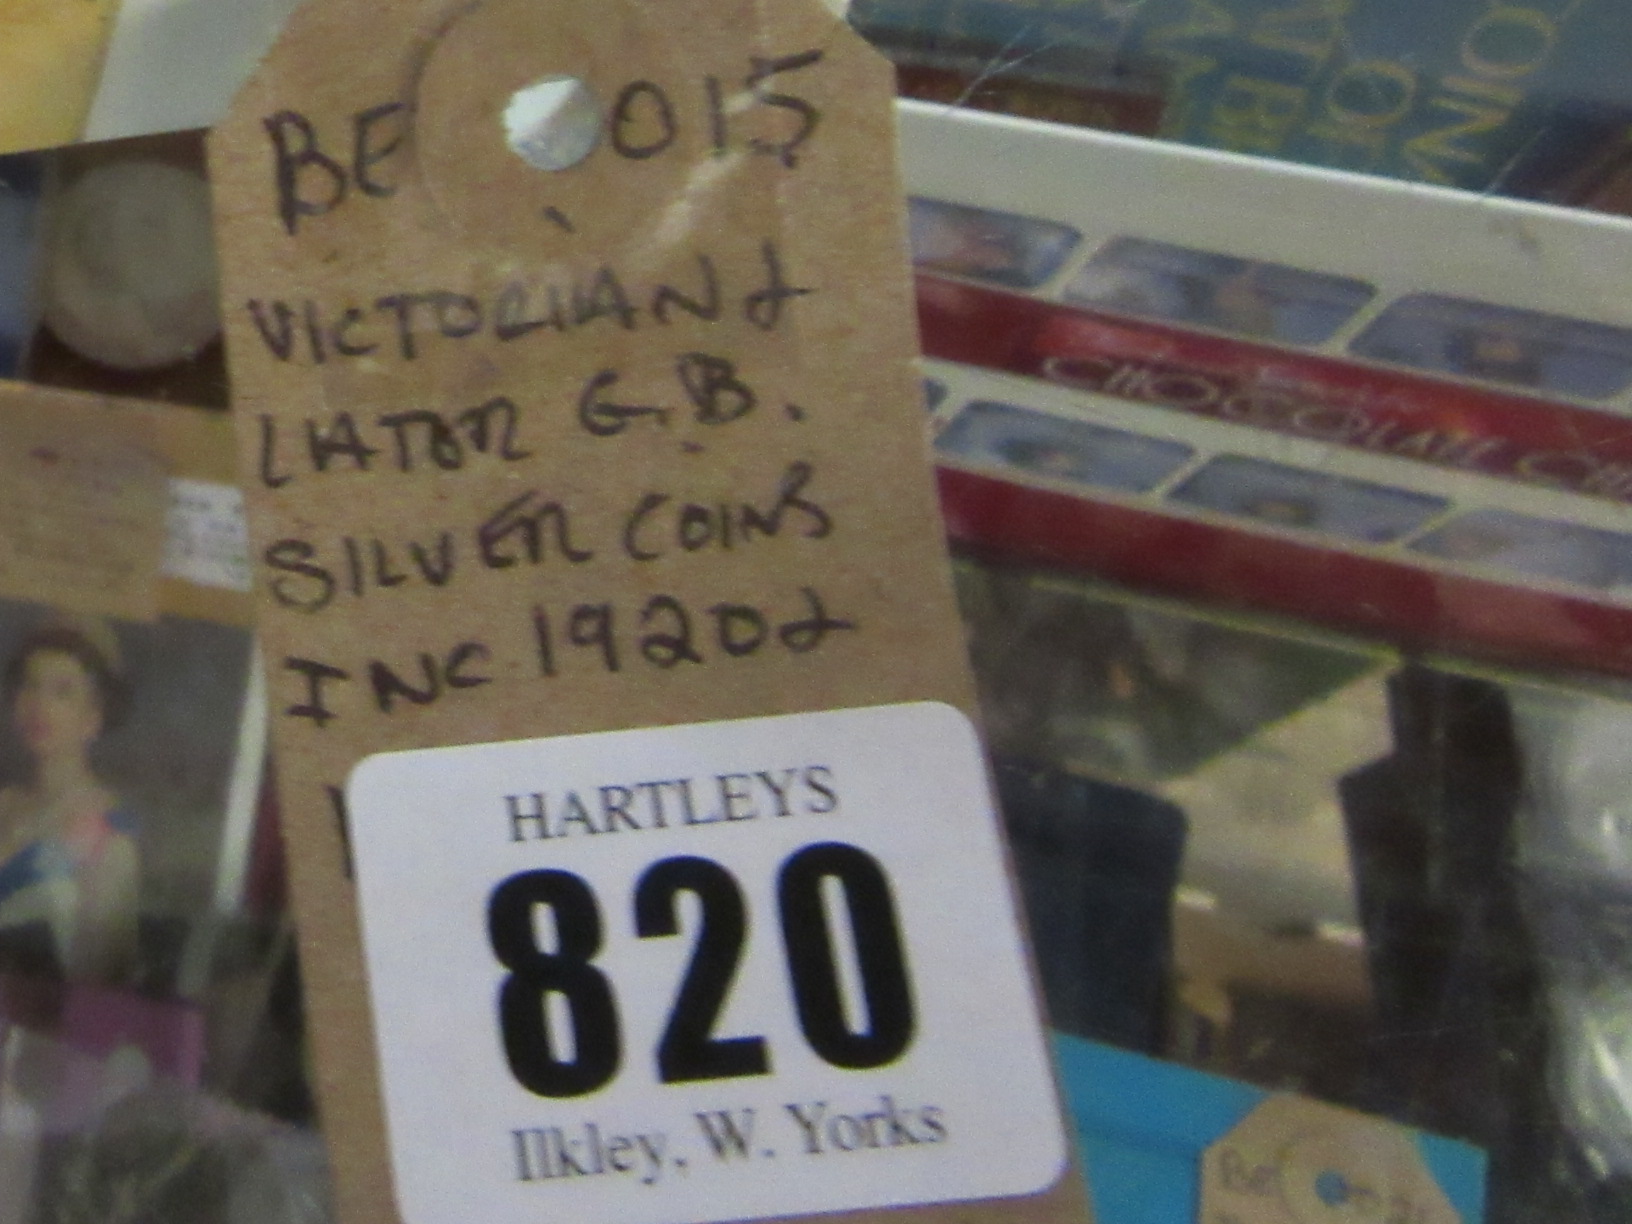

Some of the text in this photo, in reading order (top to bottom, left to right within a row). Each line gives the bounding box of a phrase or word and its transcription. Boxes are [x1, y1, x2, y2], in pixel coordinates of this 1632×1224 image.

[505, 765, 839, 843] HARTLEYS
[486, 840, 918, 1101] 820
[511, 1096, 949, 1185] Ilkley, W. Yorks
